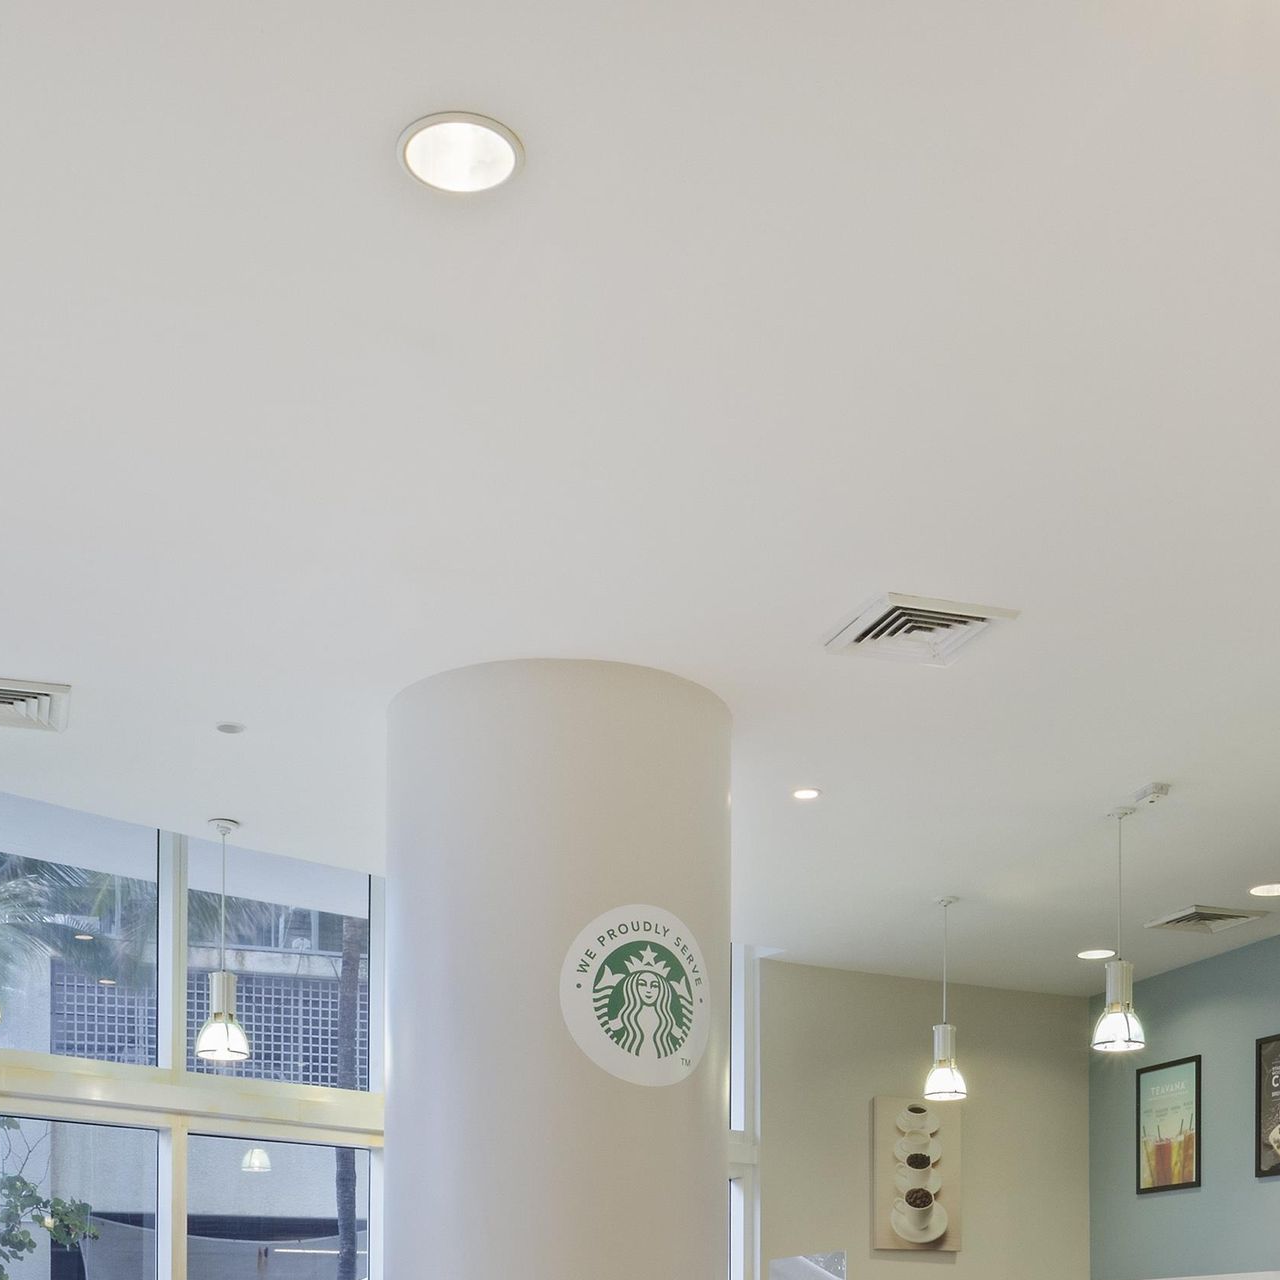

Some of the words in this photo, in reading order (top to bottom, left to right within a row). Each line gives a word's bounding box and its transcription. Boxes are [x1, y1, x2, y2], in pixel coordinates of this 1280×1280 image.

[577, 948, 596, 975] WE
[597, 921, 670, 947] PROUDLY
[674, 937, 703, 986] SERVE
[1150, 1081, 1186, 1096] TEAVANA
